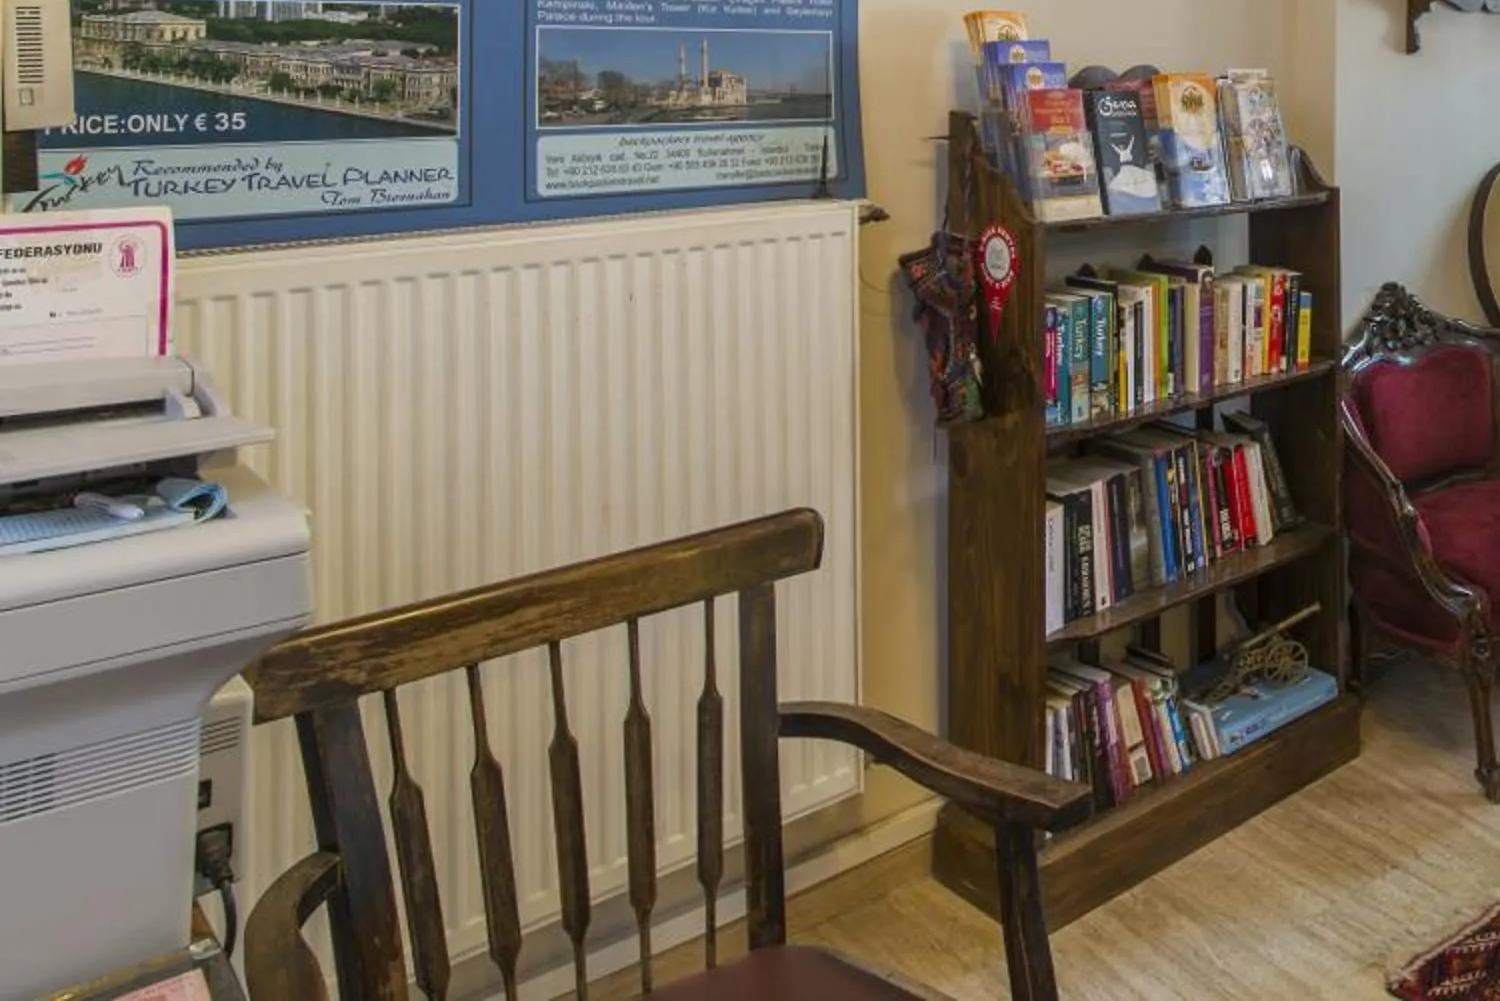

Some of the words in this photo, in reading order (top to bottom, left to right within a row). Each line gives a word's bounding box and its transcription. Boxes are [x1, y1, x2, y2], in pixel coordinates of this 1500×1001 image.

[44, 113, 189, 136] RICE:ONLY
[214, 111, 246, 131] 35
[129, 177, 236, 198] TURKEY
[240, 171, 338, 191] TRAVEL
[343, 167, 455, 187] PLANNER
